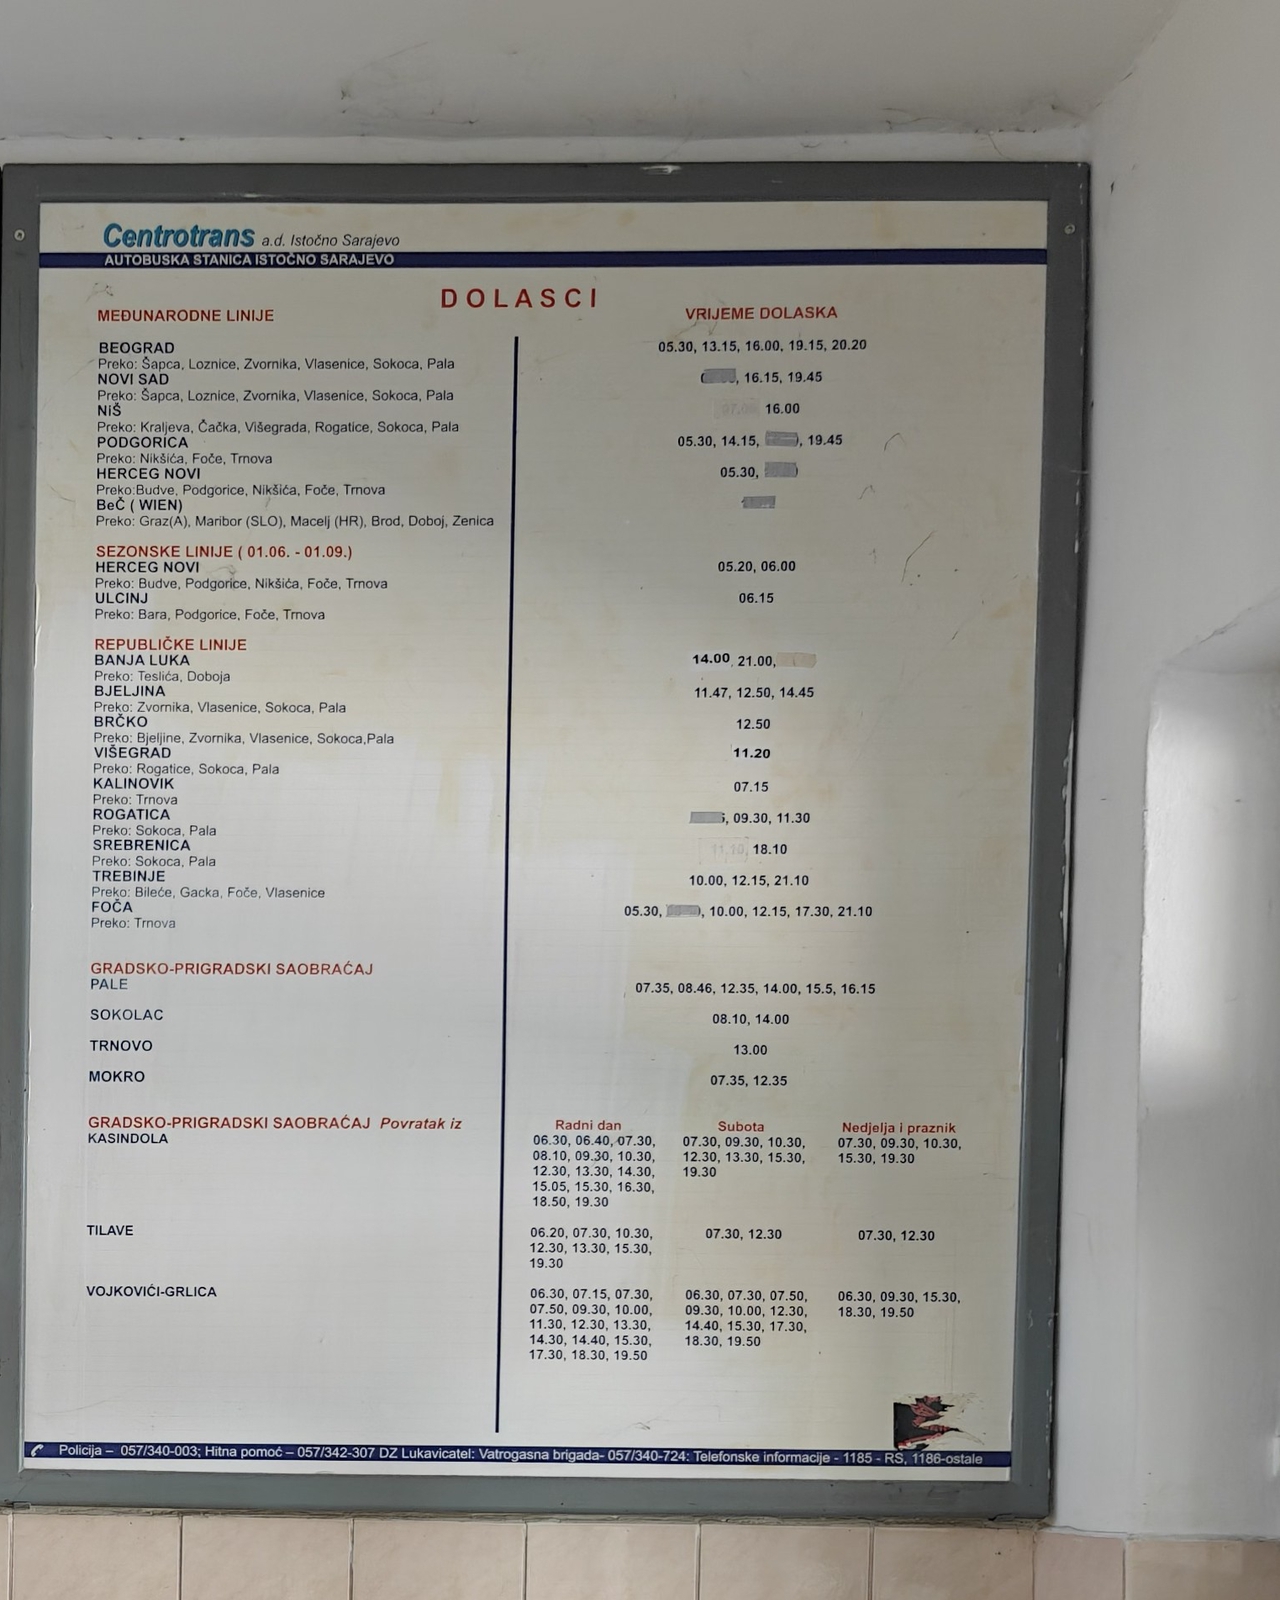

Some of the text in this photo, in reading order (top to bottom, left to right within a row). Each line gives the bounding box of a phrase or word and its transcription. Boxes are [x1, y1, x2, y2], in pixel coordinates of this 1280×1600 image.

[103, 223, 400, 250] Centrotrans a.d. Istočno Sarajevo
[104, 250, 395, 266] AUTOBUSKA STANICA ISTOČNO SARAJEVO
[98, 309, 274, 322] MEĐUNARODNE LINIJE
[685, 306, 838, 320] VRIJEME DOLASKA
[99, 342, 175, 354] BEOGRAD
[658, 339, 867, 354] 05.30, 13.15, 16.00, 19.15, 20.20
[98, 373, 170, 386] NOVI SAD
[97, 418, 459, 436] Preko: Kraljeva, Čačka, Višegrada, Rogatice, Sokoca, Pala
[97, 436, 189, 448] PODGORICA
[96, 467, 201, 480] HERCEG NOVI
[95, 592, 148, 604] ULCINJ
[95, 635, 247, 651] REPUBLIČKE LINIJE
[94, 654, 190, 666] BANJA LUKA
[94, 685, 166, 697] BJELJINA
[94, 712, 148, 728] BRČKO
[736, 718, 771, 730] 12.50
[94, 743, 172, 759] VIŠEGRAD
[93, 777, 174, 790] KALINOVIK
[734, 781, 769, 792] 07.15
[93, 808, 171, 820] ROGATICA
[92, 839, 191, 851] SREBRENICA
[92, 870, 166, 882] TREBINJE
[91, 898, 133, 913] FOČA
[90, 960, 373, 975] GRADSKO-PRIGRADSKI SAOBRAĆAJ
[90, 978, 128, 990] PALE
[635, 982, 876, 996] 07.35, 08.46, 12.35, 14.00, 15.5, 16.15
[90, 1008, 164, 1021] SOKOLAC
[89, 1040, 153, 1052] TRNOVO
[89, 1070, 145, 1082] MOKRO
[88, 1114, 462, 1130] GRADSKO-PRIGRADSKI SAOBRAĆAJ Povratak iz
[555, 1119, 622, 1131] Radni dan
[718, 1121, 765, 1132] Subota
[842, 1122, 956, 1136] Nedjelja i praznik
[88, 1133, 169, 1144] KASINDOLA
[86, 1224, 134, 1236] TILAVE
[86, 1282, 218, 1297] VOJKOVIĆI-GRLICA
[59, 1444, 102, 1459] Policija
[205, 1446, 238, 1457] Hitna
[240, 1446, 283, 1460] pomoć
[297, 1446, 376, 1458] 057/342-307
[379, 1447, 398, 1459] DZ
[478, 1448, 550, 1463] Vatrogasna
[692, 1450, 760, 1462] Telefonske
[763, 1452, 831, 1466] informacije
[843, 1452, 873, 1464] 1185
[884, 1452, 907, 1466] RS,
[912, 1452, 983, 1464] 1186-ostale
